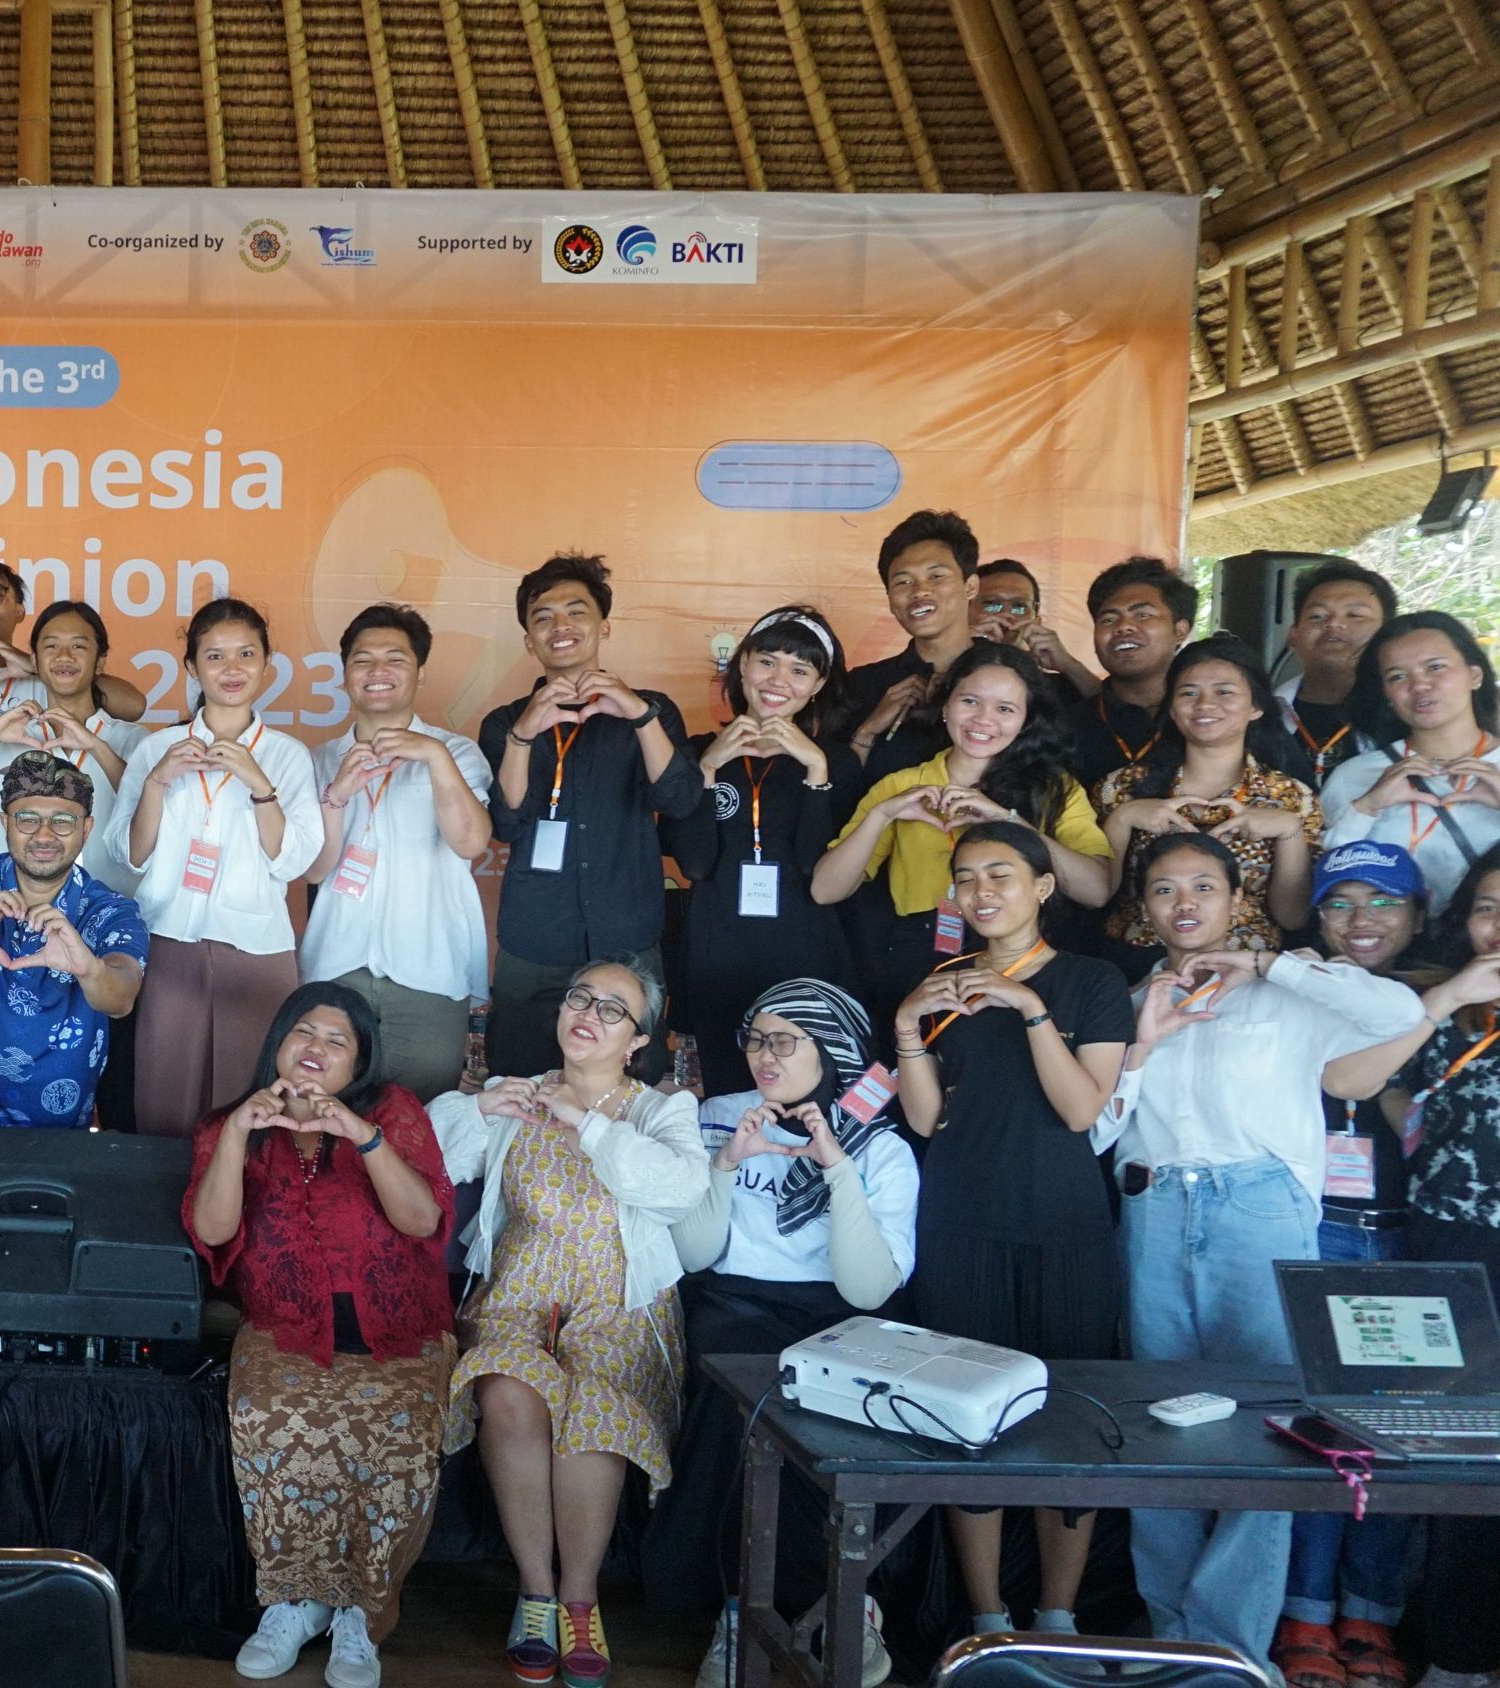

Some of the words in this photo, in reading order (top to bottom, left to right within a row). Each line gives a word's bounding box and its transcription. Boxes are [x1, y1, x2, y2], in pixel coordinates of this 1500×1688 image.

[87, 234, 199, 252] Co-organized
[204, 234, 224, 252] by
[418, 235, 506, 253] Supported
[513, 235, 532, 253] by
[672, 242, 743, 263] BAKTI
[612, 267, 659, 275] KOMINFO
[57, 359, 105, 394] 3rd
[130, 649, 351, 727] 223
